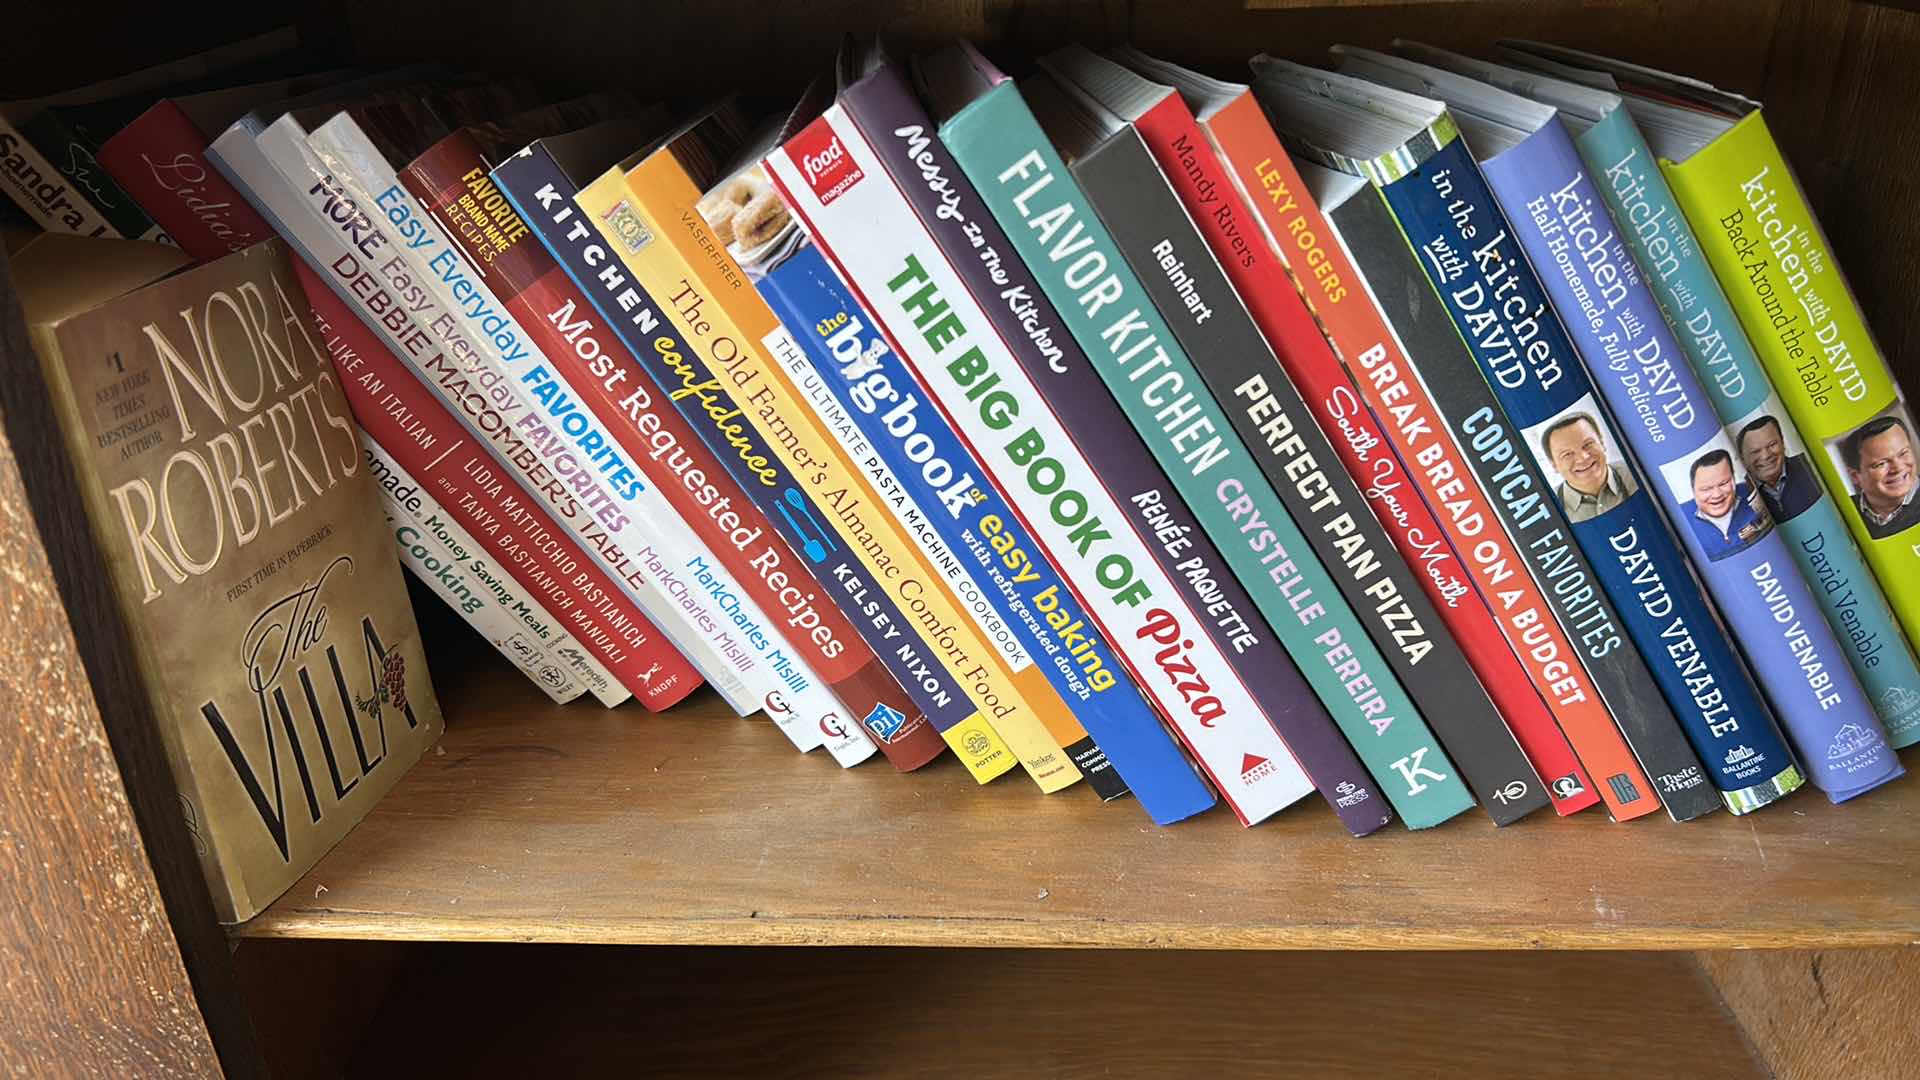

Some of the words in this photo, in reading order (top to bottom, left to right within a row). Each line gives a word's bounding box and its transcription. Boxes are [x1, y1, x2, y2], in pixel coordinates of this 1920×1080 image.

[0, 133, 84, 232] Sandra
[141, 152, 249, 258] Lidia's
[458, 194, 486, 229] BRAND
[482, 222, 511, 253] NAME
[461, 167, 530, 245] FAVORITE
[803, 135, 843, 186] food
[821, 169, 863, 204] magazine
[445, 203, 498, 264] RECIPES
[680, 211, 743, 291] VASERFIRER
[1431, 169, 1455, 199] in
[1447, 198, 1478, 240] the
[1472, 230, 1565, 391] kitchen
[1550, 171, 1629, 310] kitchen
[1621, 306, 1645, 338] with
[1633, 336, 1696, 432] DAVID
[1605, 147, 1681, 283] kitchen
[1672, 280, 1697, 310] with
[1685, 308, 1746, 400] DAVID
[1612, 243, 1627, 265] in
[1621, 263, 1639, 287] the
[1666, 216, 1681, 236] in
[1675, 232, 1693, 258] the
[1740, 165, 1810, 295] kitchen
[1805, 287, 1827, 323] with
[1816, 321, 1868, 403] DAVID
[1796, 231, 1811, 251] in
[1805, 249, 1824, 275] the
[142, 271, 326, 442] NORA
[815, 310, 848, 338] the
[1171, 133, 1218, 205] Mandy
[1213, 202, 1256, 269] Rivers
[1325, 385, 1380, 463] South
[1366, 458, 1409, 528] Your
[1407, 528, 1469, 608] Mouth
[1429, 233, 1471, 282] with
[1452, 280, 1528, 390] DAVID
[1528, 195, 1556, 239] Half
[1547, 234, 1604, 334] Homemade,
[1600, 331, 1630, 373] Fully
[1620, 371, 1667, 445] Delicious
[1720, 208, 1756, 263] Back
[1744, 259, 1797, 331] Around
[1782, 323, 1806, 360] the
[1796, 355, 1831, 408] Table
[97, 404, 171, 448] BESTSELLING
[120, 431, 163, 461] AUTHOR
[309, 175, 388, 260] MORE
[380, 256, 435, 312] Easy
[430, 313, 522, 412] Everyday
[515, 411, 631, 533] FAVORITES
[638, 546, 718, 633] MarkCharles
[714, 632, 755, 672] Misilli
[327, 336, 365, 373] LIKE
[358, 372, 385, 395] AN
[380, 393, 437, 450] ITALIAN
[331, 252, 433, 356] DEBBIE
[424, 353, 584, 520] MACOMBER'S
[580, 516, 646, 592] TABLE
[375, 184, 435, 249] Easy
[429, 248, 529, 362] Everyday
[521, 365, 645, 502] FAVORITES
[686, 555, 769, 651] MarkCharles
[766, 648, 810, 693] Misilli
[534, 183, 660, 336] KITCHEN
[654, 335, 779, 488] confidence
[832, 562, 901, 641] KELSEY
[896, 643, 952, 709] NIXON
[881, 393, 977, 520] book
[894, 125, 964, 222] Messy
[980, 247, 1009, 285] The
[1001, 285, 1068, 374] Kitchen
[1131, 489, 1194, 559] RENÉE
[1176, 556, 1260, 655] PAQUETTE
[997, 149, 1124, 319] FLAVOR
[1101, 307, 1231, 477] KITCHEN
[1215, 478, 1326, 627] CRYSTELLE
[1314, 626, 1395, 737] PEREIRA
[1152, 239, 1213, 325] Reinhart
[1234, 373, 1342, 514] PERFECT
[1322, 511, 1382, 581] PAN
[1364, 577, 1434, 666] PIZZA
[1254, 157, 1298, 215] LEXY
[1287, 215, 1348, 304] ROGERS
[1358, 342, 1433, 446] BREAK
[1415, 442, 1484, 537] BREAD
[1474, 539, 1515, 586] ON
[1497, 587, 1525, 610] A
[1511, 607, 1587, 708] BUDGET
[109, 372, 360, 604] ROBERTS
[547, 299, 627, 392] Most
[618, 385, 763, 553] Requested
[750, 545, 844, 660] Recipes
[669, 279, 712, 337] The
[711, 336, 759, 389] Old
[747, 384, 829, 486] Farmer's
[822, 487, 901, 580] Almanac
[899, 578, 969, 668] Comfort
[965, 663, 1017, 720] Food
[775, 335, 804, 374] THE
[803, 374, 869, 457] ULTIMATE
[864, 457, 906, 508] PASTA
[903, 510, 962, 580] MACHINE
[958, 581, 1027, 665] COOKBOOK
[886, 253, 968, 355] THE
[945, 345, 1020, 430] BIG
[1004, 427, 1113, 559] BOOK
[1095, 554, 1153, 609] OF
[1136, 607, 1227, 728] Pizza
[970, 487, 990, 504] of
[1462, 405, 1551, 530] COPYCAT
[1529, 527, 1622, 660] FAVORITES
[226, 581, 253, 602] FIRST
[253, 564, 277, 585] TIME
[288, 524, 333, 566] PAPERBACK
[396, 526, 485, 614] Cooking
[424, 515, 471, 562] Money
[470, 560, 514, 606] Saving
[512, 602, 550, 640] Meals
[438, 476, 458, 495] and
[458, 492, 501, 537] TANYA
[498, 534, 574, 610] BASTIANICH
[570, 609, 627, 664] MANUALI
[463, 457, 503, 499] LIDIA
[500, 496, 576, 575] MATTICCHIO
[572, 573, 648, 650] BASTIANICH
[961, 529, 990, 567] with
[987, 565, 1061, 656] refrigerated
[1053, 654, 1092, 702] dough
[978, 513, 1040, 583] easy
[1032, 585, 1117, 693] baking
[1802, 531, 1846, 596] David
[1835, 591, 1881, 670] Venable
[242, 555, 353, 693] The
[648, 674, 680, 697] KNOPF
[1609, 526, 1673, 618] DAVID
[1660, 616, 1740, 739] VENABLE
[1750, 561, 1795, 624] DAVID
[1785, 621, 1842, 711] VENABLE
[200, 617, 417, 863] VILLA
[975, 750, 1003, 769] POTTER
[1090, 760, 1112, 774] PRESS
[1244, 764, 1278, 785] HOME
[1390, 746, 1447, 796] K
[1657, 766, 1697, 785] Taste
[1670, 774, 1703, 792] Home
[1722, 752, 1767, 775] BALLANTINE
[1735, 765, 1762, 780] BOOKS
[1846, 755, 1880, 774] BOOKS
